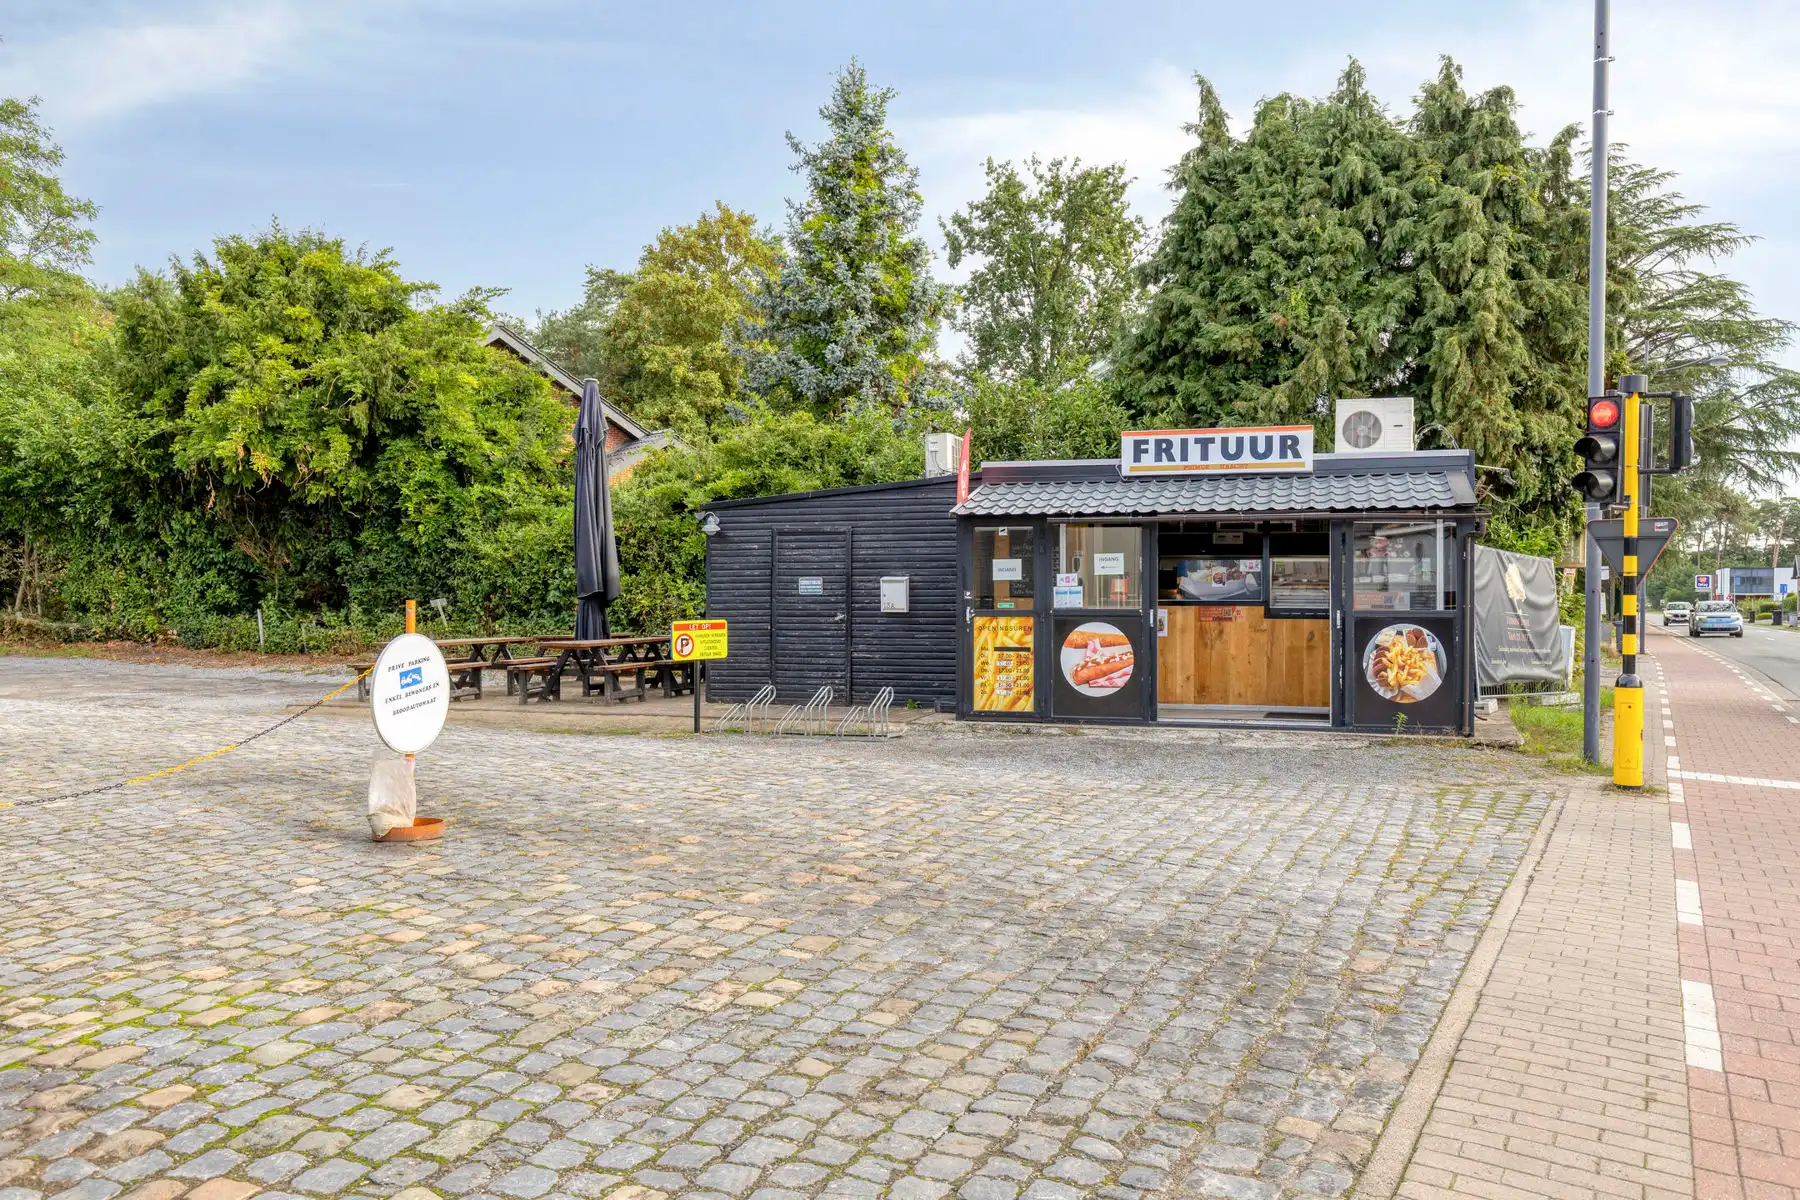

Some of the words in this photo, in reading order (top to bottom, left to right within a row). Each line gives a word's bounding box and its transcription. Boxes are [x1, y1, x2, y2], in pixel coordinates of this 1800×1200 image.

[1132, 434, 1302, 464] FRITUUR
[408, 656, 430, 667] PARKING
[385, 694, 402, 704] ENKEL
[405, 684, 432, 698] BEWONERS
[432, 681, 440, 689] EN
[392, 697, 437, 716] BROODAUTOMAAT
